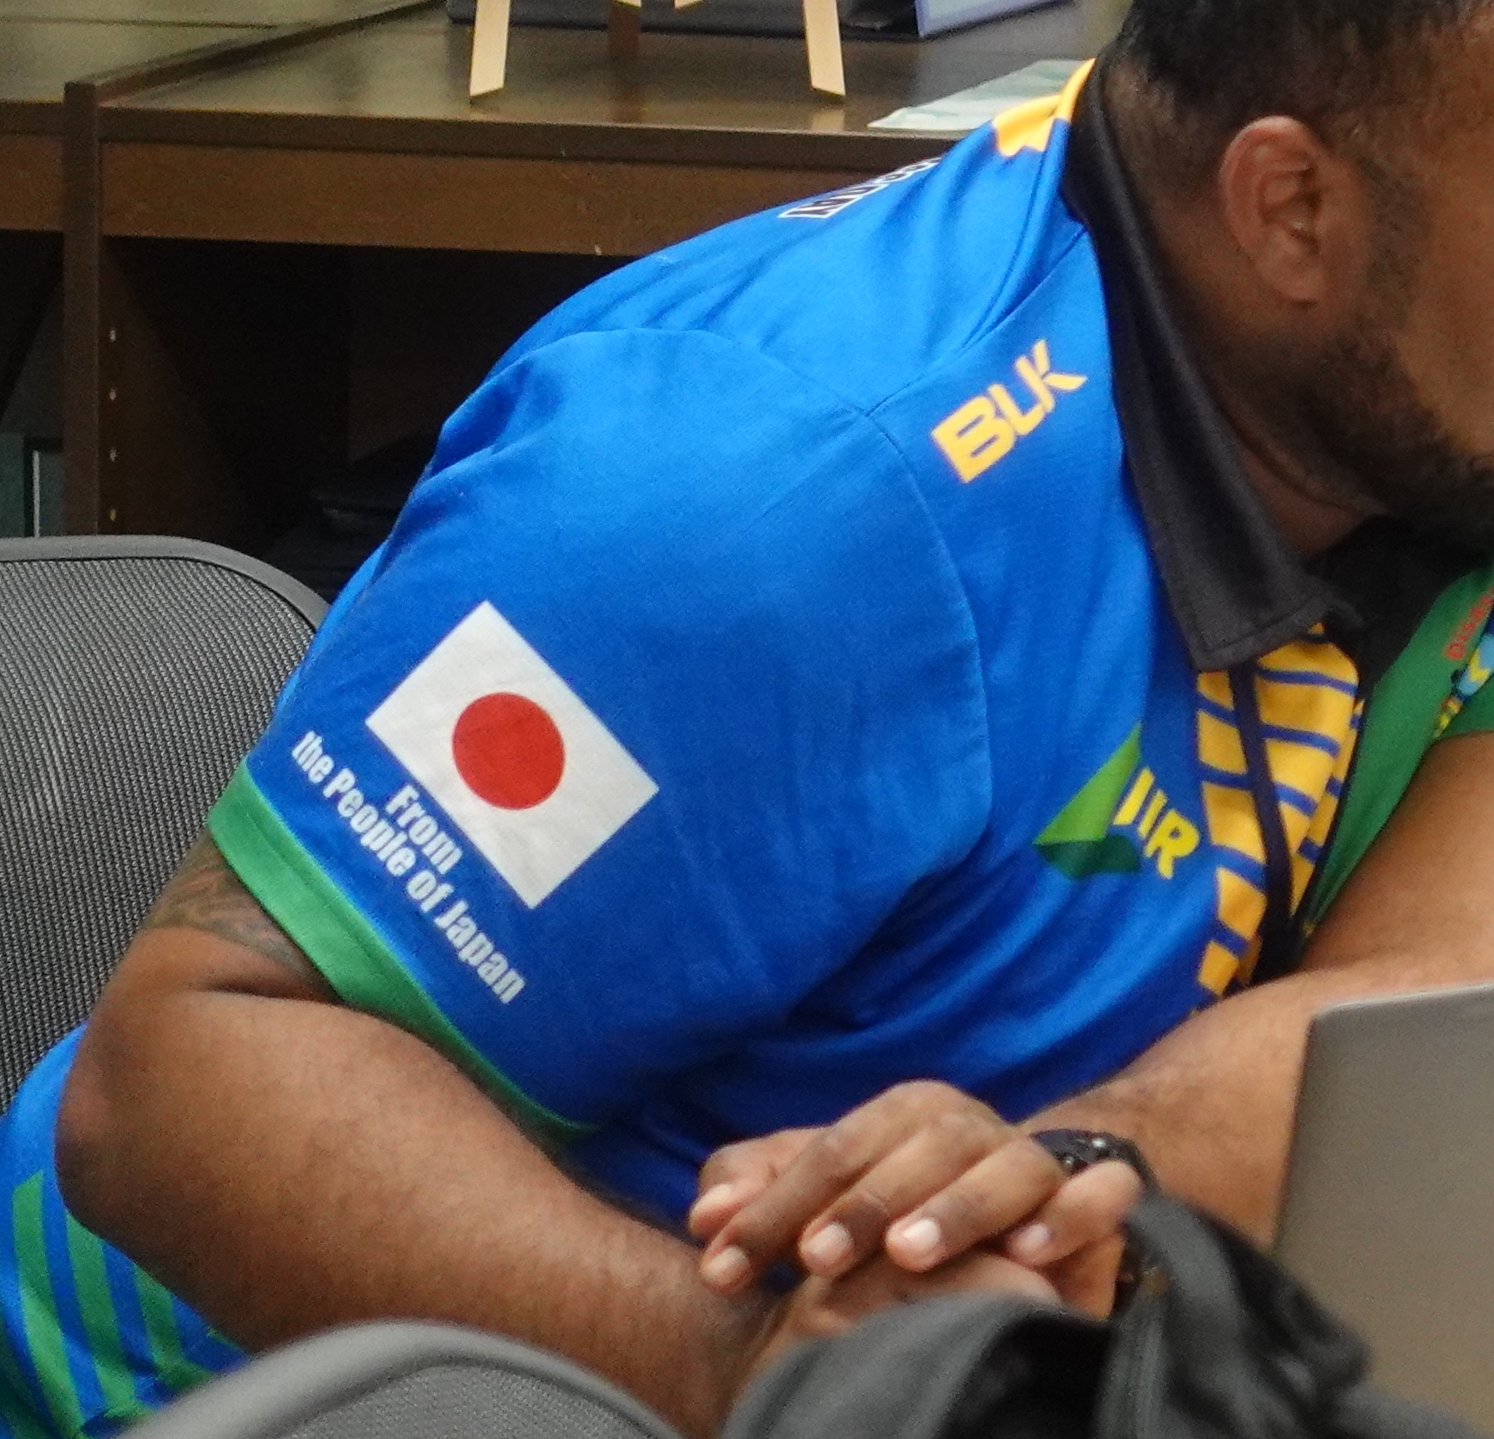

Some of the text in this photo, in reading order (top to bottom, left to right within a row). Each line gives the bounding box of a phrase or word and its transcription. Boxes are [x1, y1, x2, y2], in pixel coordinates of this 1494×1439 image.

[930, 339, 1089, 484] BLK
[291, 730, 527, 1005] the People of Japan
[386, 785, 463, 875] From
